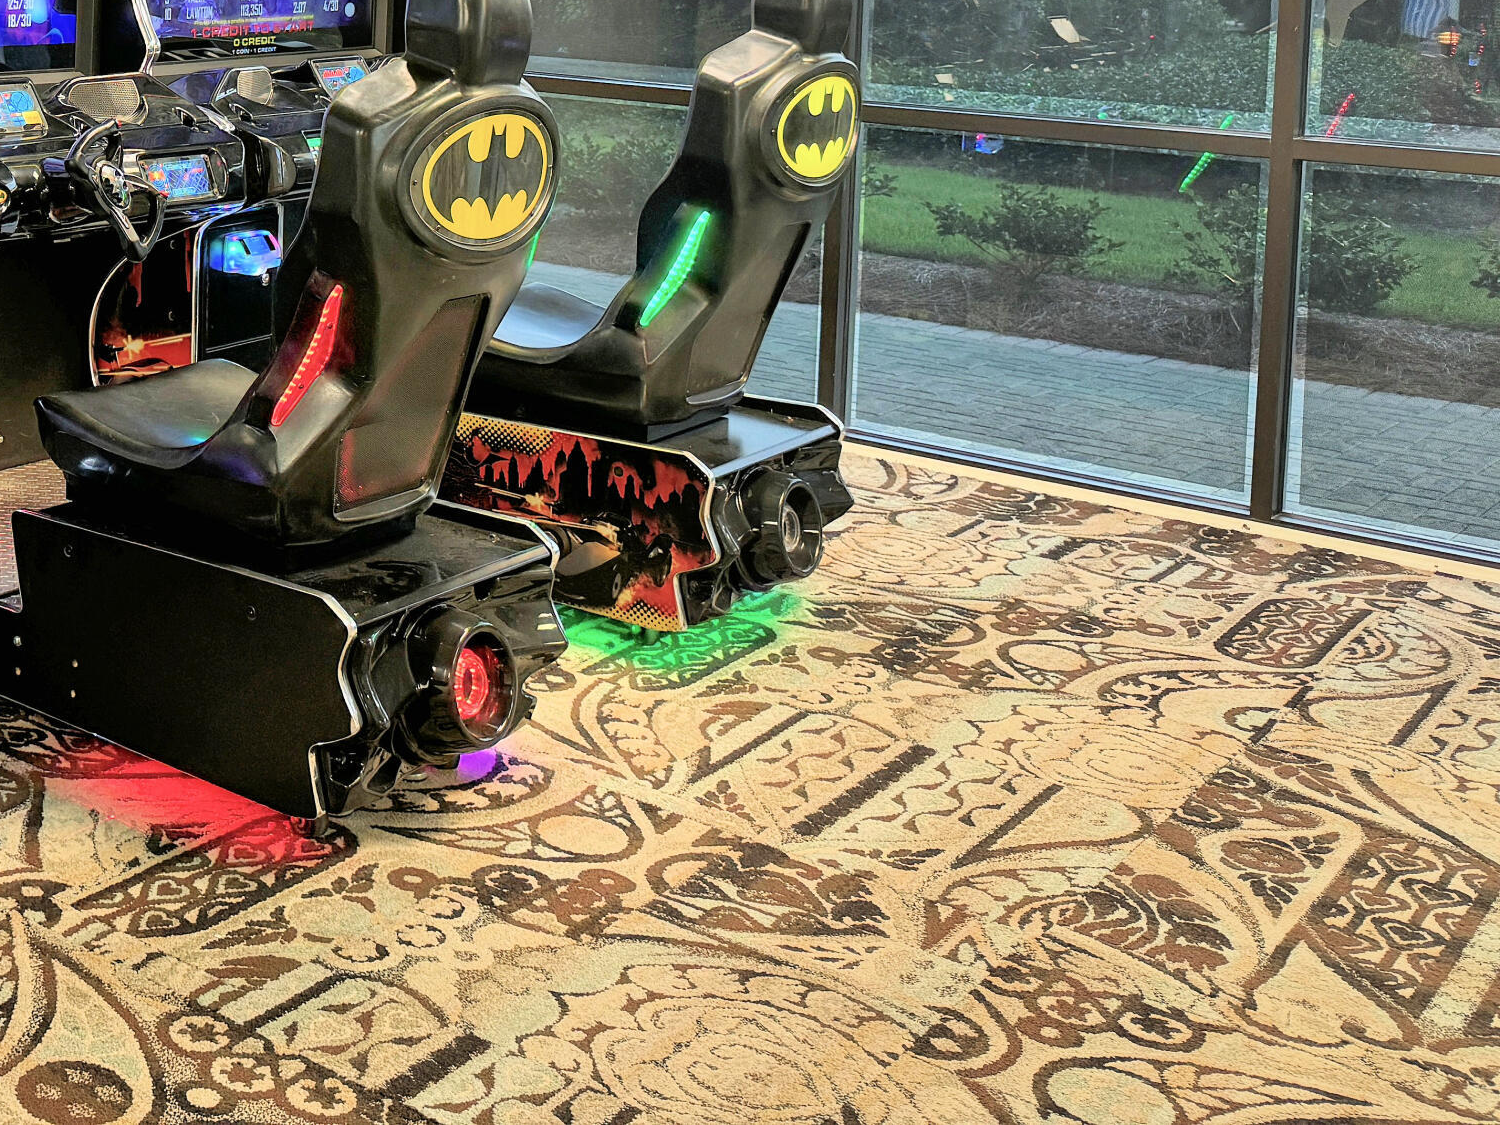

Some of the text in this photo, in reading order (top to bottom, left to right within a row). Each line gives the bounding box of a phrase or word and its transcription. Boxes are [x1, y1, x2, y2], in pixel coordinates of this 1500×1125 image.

[164, 7, 172, 21] 10
[186, 6, 214, 20] LAWTON
[293, 1, 306, 14] 2:07
[323, 0, 339, 12] 4/30
[7, 13, 32, 28] 18/30
[202, 24, 250, 38] CREDIT
[254, 23, 271, 35] TO
[241, 36, 277, 47] CREDIT
